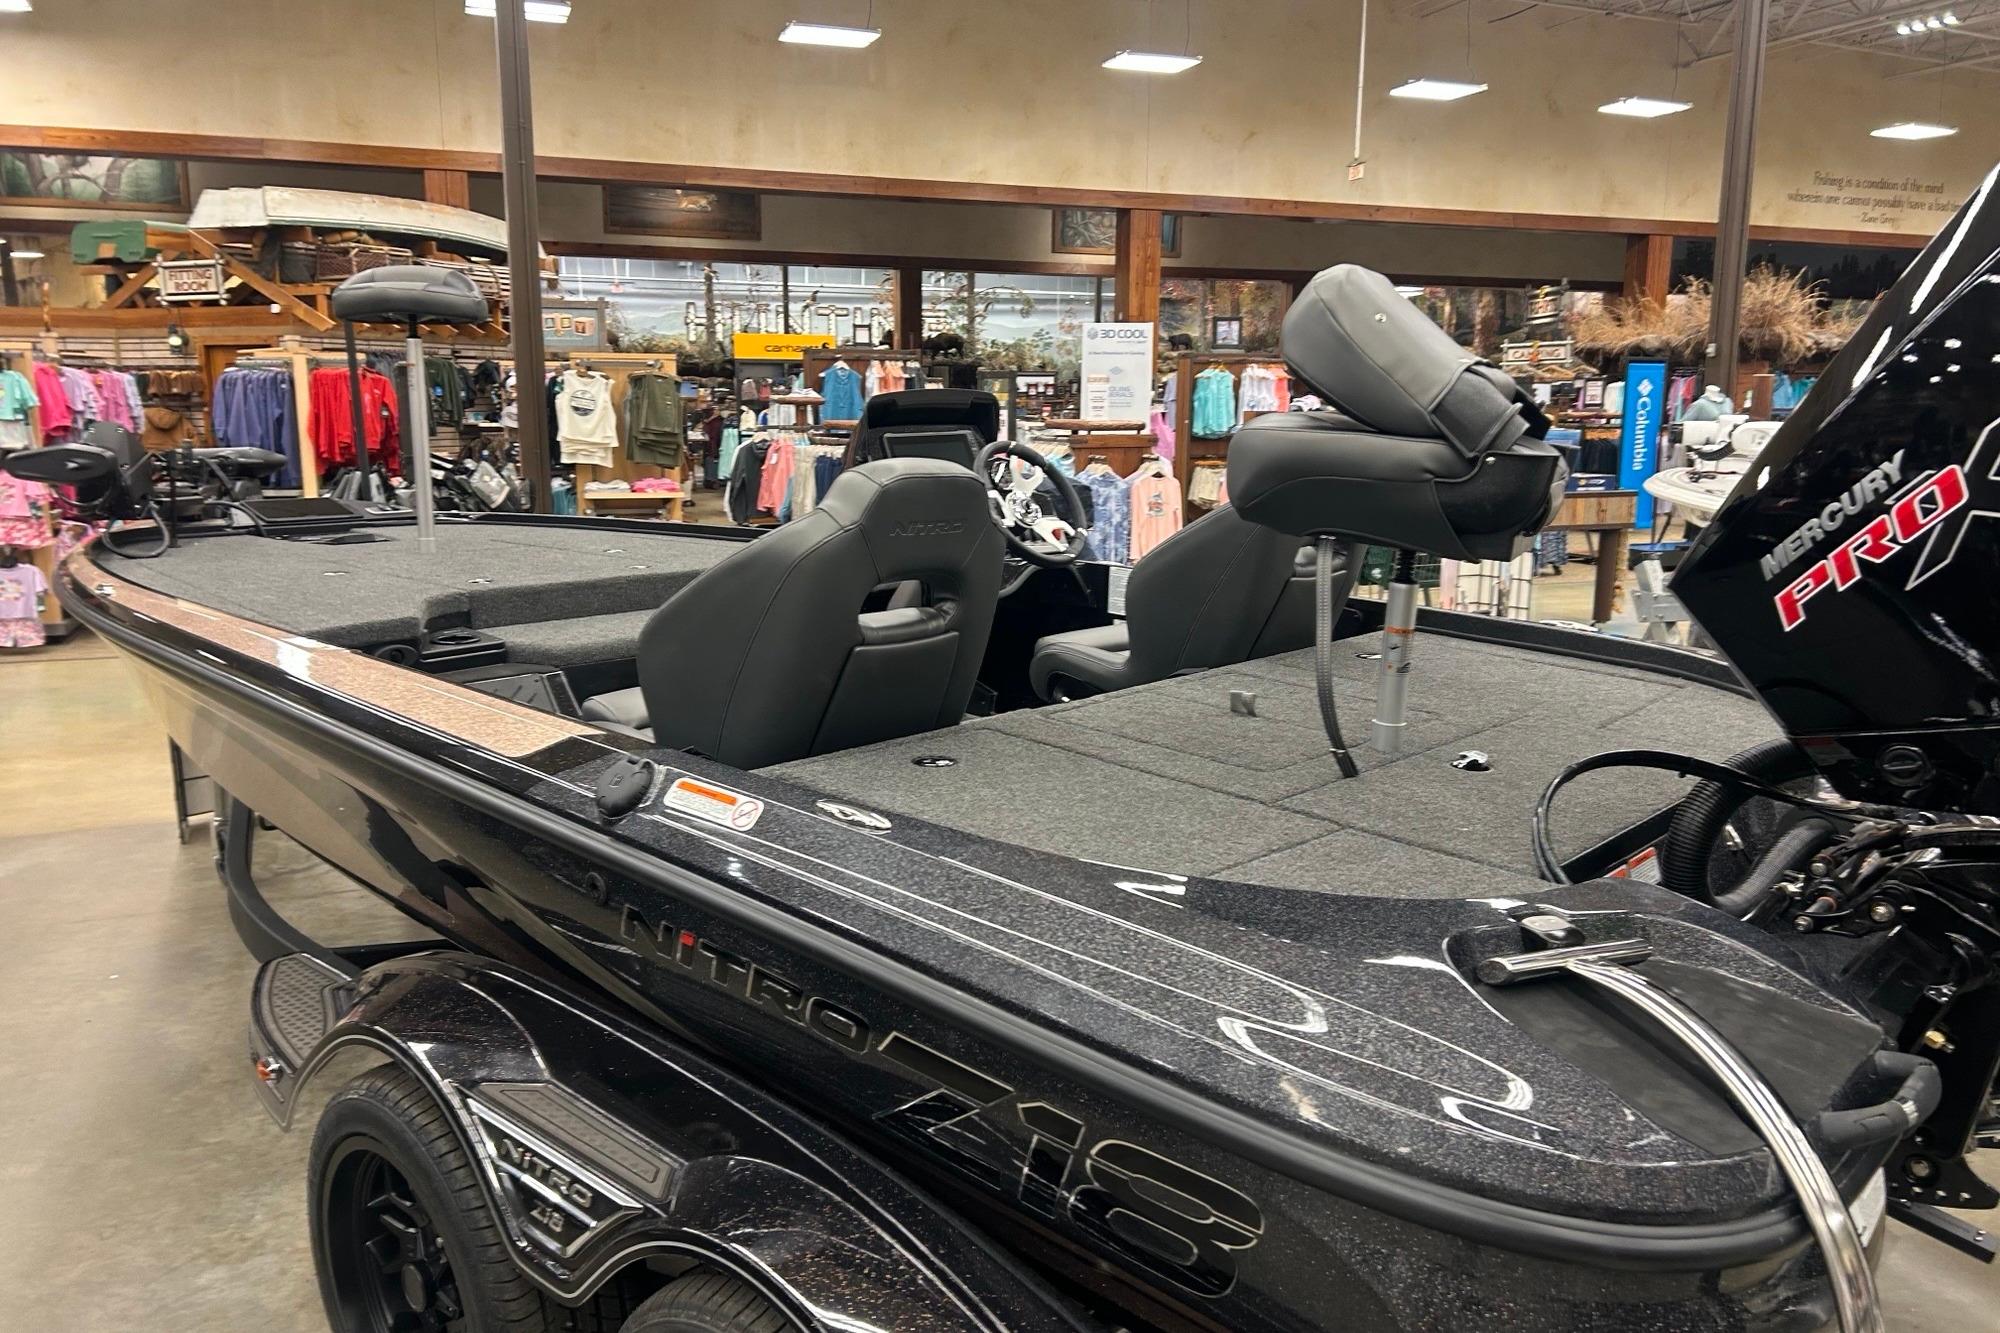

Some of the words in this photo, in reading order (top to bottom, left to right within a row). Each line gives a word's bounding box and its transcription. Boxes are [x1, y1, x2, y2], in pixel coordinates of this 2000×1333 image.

[1862, 177, 1898, 191] condition
[1900, 177, 1909, 191] of
[1911, 179, 1922, 192] the
[1925, 182, 1944, 194] mind
[168, 269, 212, 280] FITTING
[174, 281, 208, 291] ROOM
[1117, 329, 1148, 339] COOL
[1511, 348, 1562, 359] CAPING
[1632, 396, 1652, 471] Columbia
[1759, 448, 1905, 582] MERCURY
[1774, 464, 1969, 632] PRO
[873, 1031, 1265, 1298] Z18
